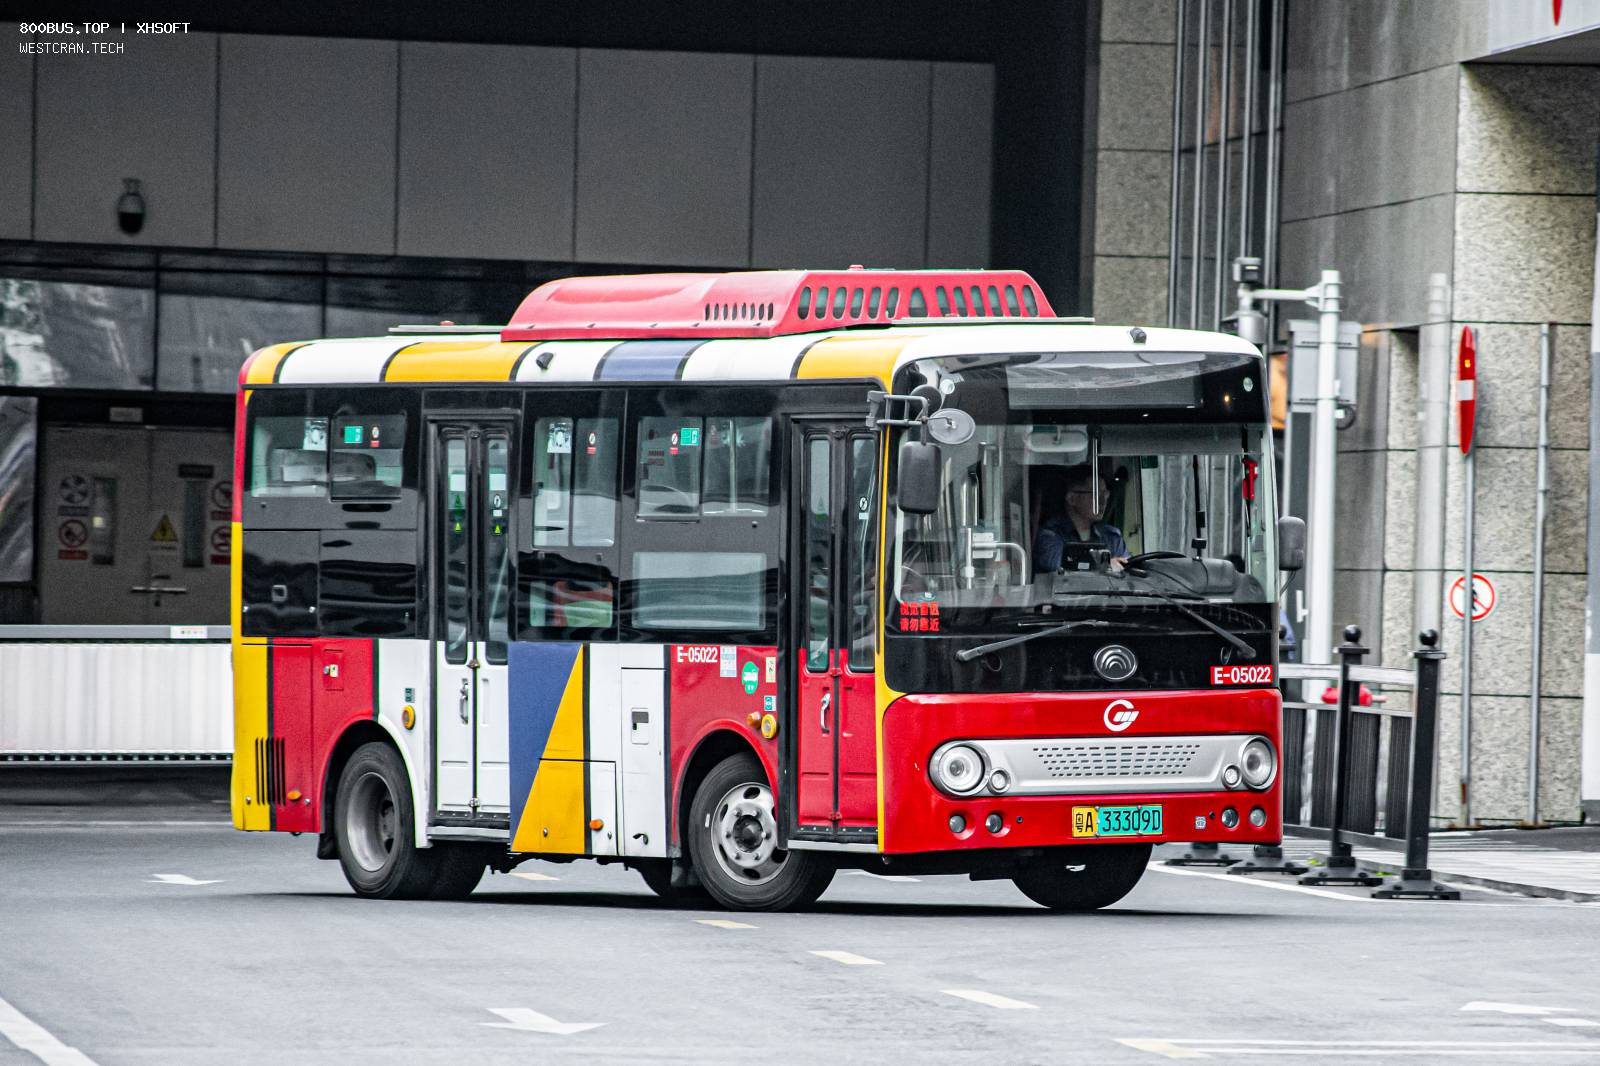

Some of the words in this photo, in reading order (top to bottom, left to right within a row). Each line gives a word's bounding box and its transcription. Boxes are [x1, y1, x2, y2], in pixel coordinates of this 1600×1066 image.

[677, 646, 718, 663] E-05022
[1214, 666, 1271, 684] E-05022
[1102, 809, 1161, 832] 33309D
